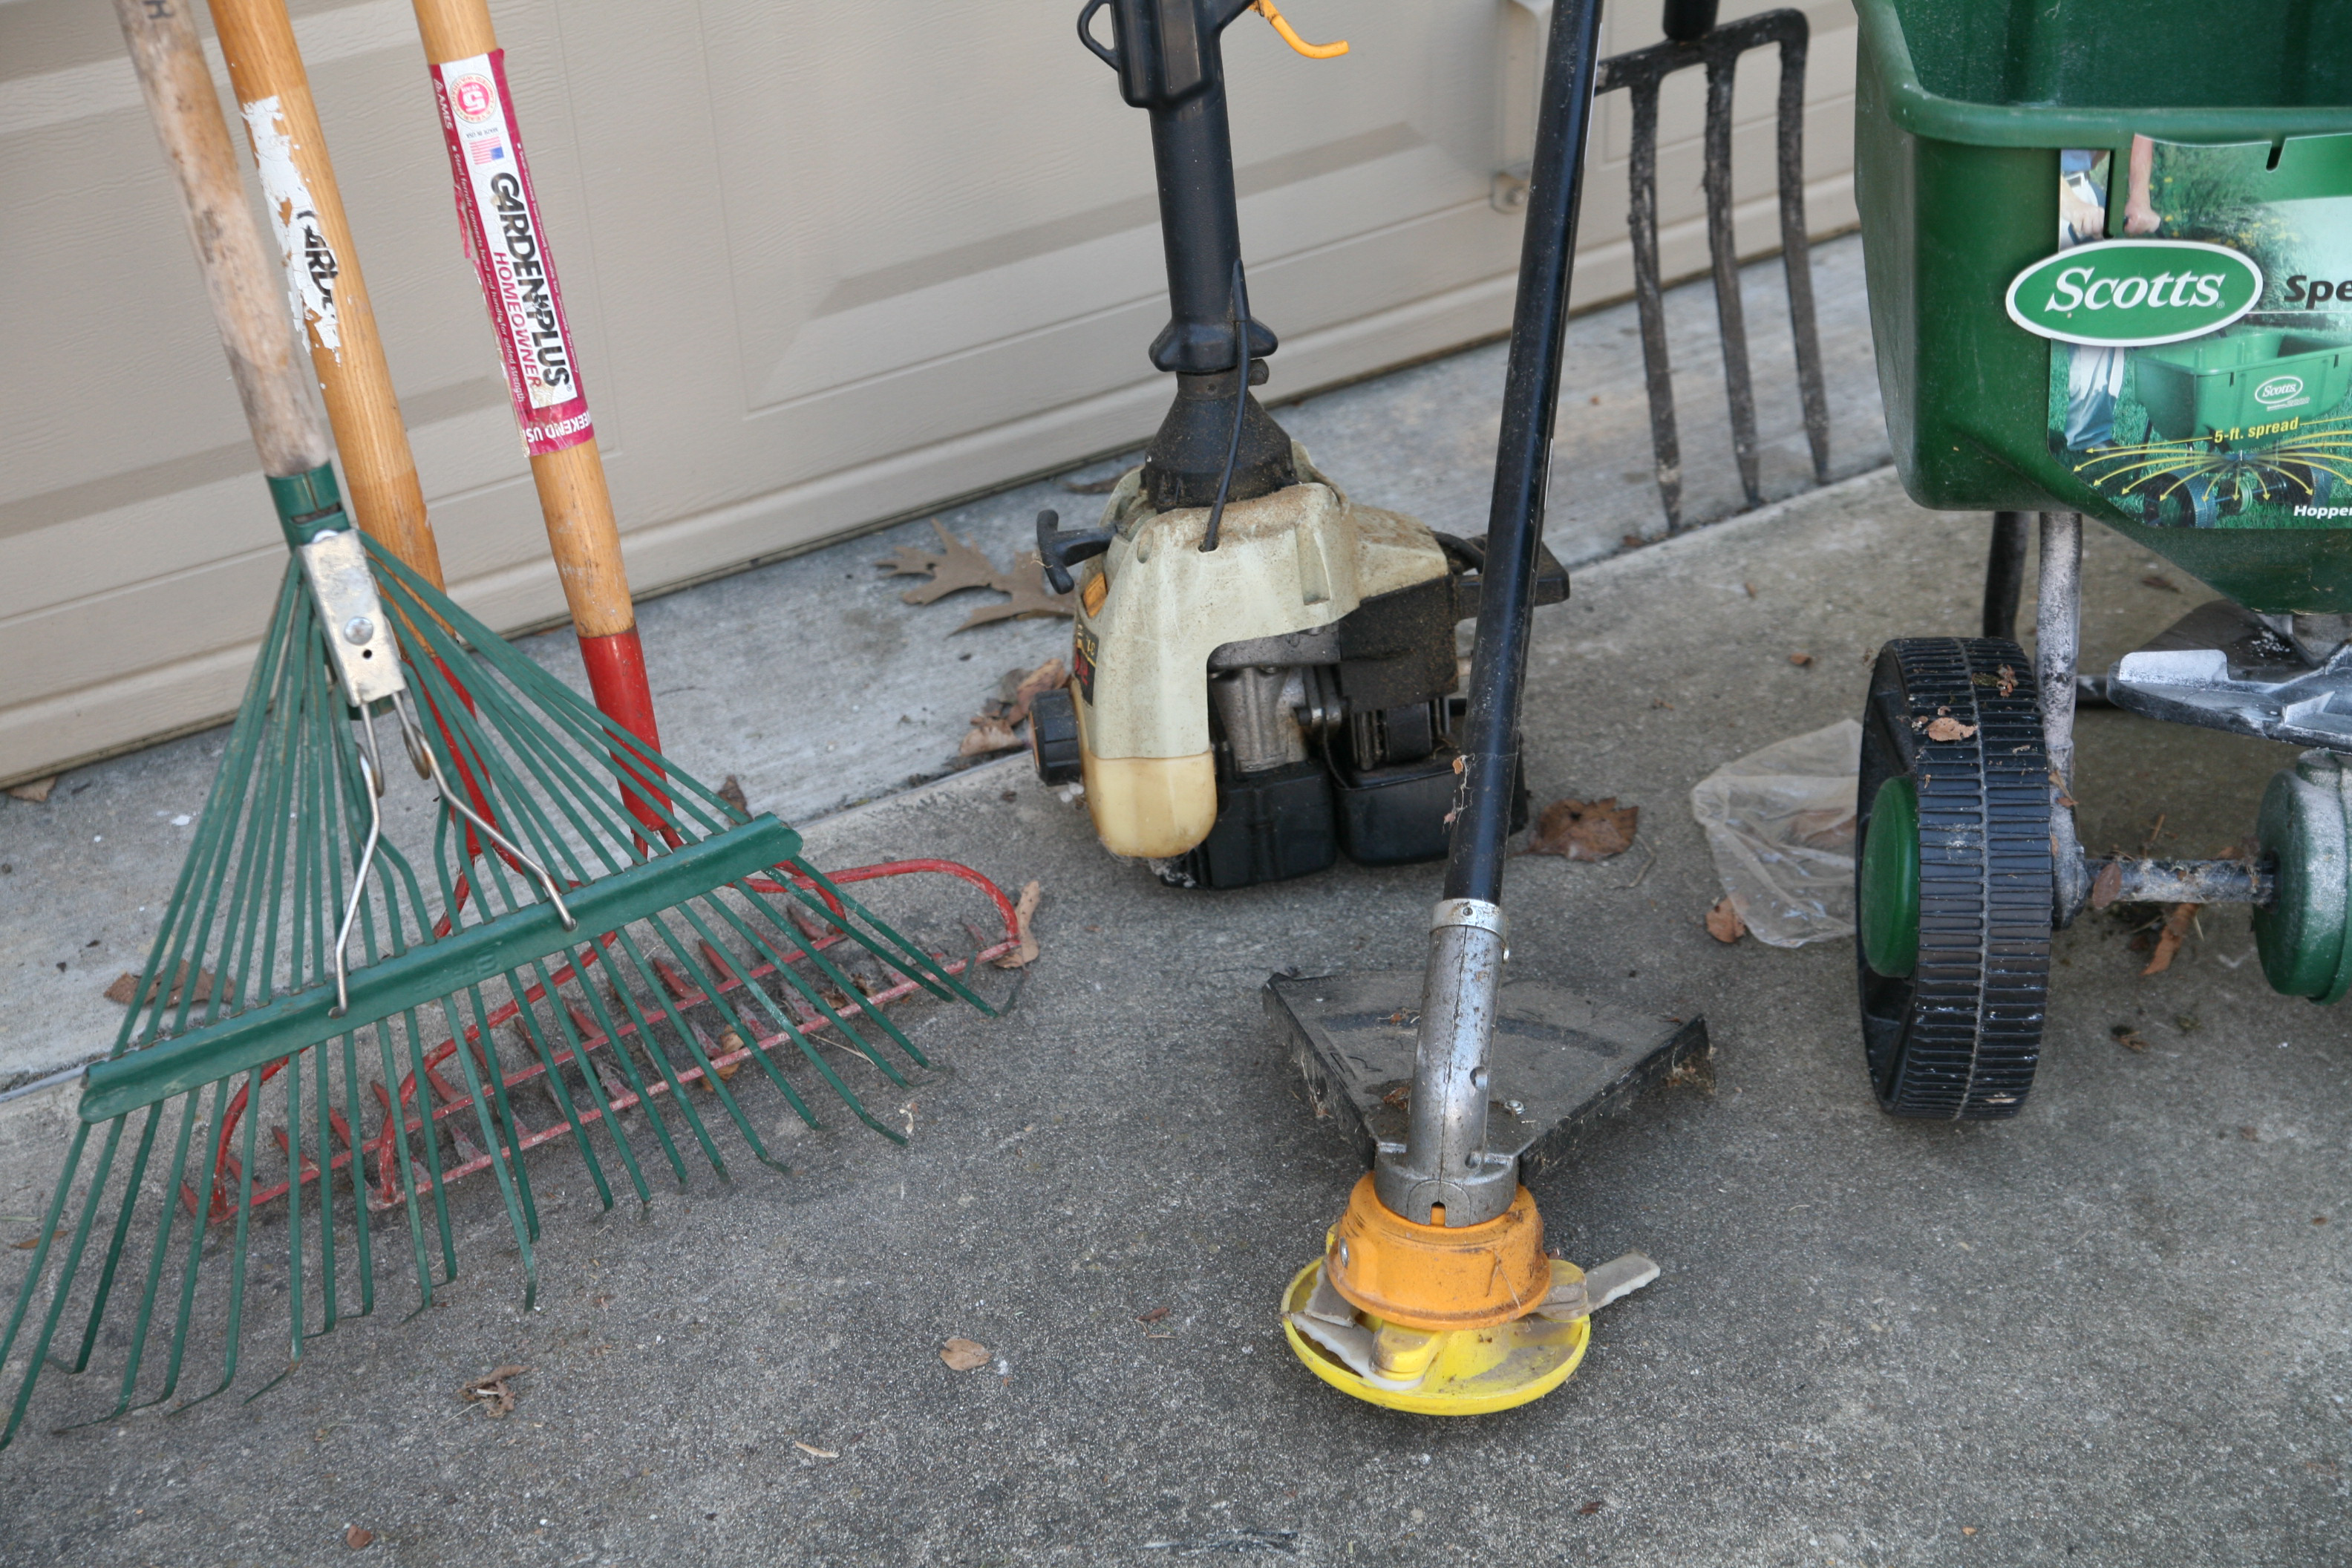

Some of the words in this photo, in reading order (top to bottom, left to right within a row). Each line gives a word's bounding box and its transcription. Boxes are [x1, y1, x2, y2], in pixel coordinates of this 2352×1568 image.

[437, 91, 454, 130] AMES
[463, 90, 487, 112] 5
[453, 152, 465, 176] Steel
[460, 177, 473, 207] ferrule
[467, 204, 483, 247] connects
[479, 249, 490, 272] head
[486, 272, 495, 290] and
[2044, 267, 2226, 312] Scotts
[493, 252, 543, 388] HOMEOWNER
[499, 322, 507, 336] for
[503, 336, 516, 364] added
[508, 365, 526, 403] strength
[2262, 384, 2296, 397] Scotts
[2214, 427, 2244, 443] 5-ft.
[2248, 416, 2300, 440] spread
